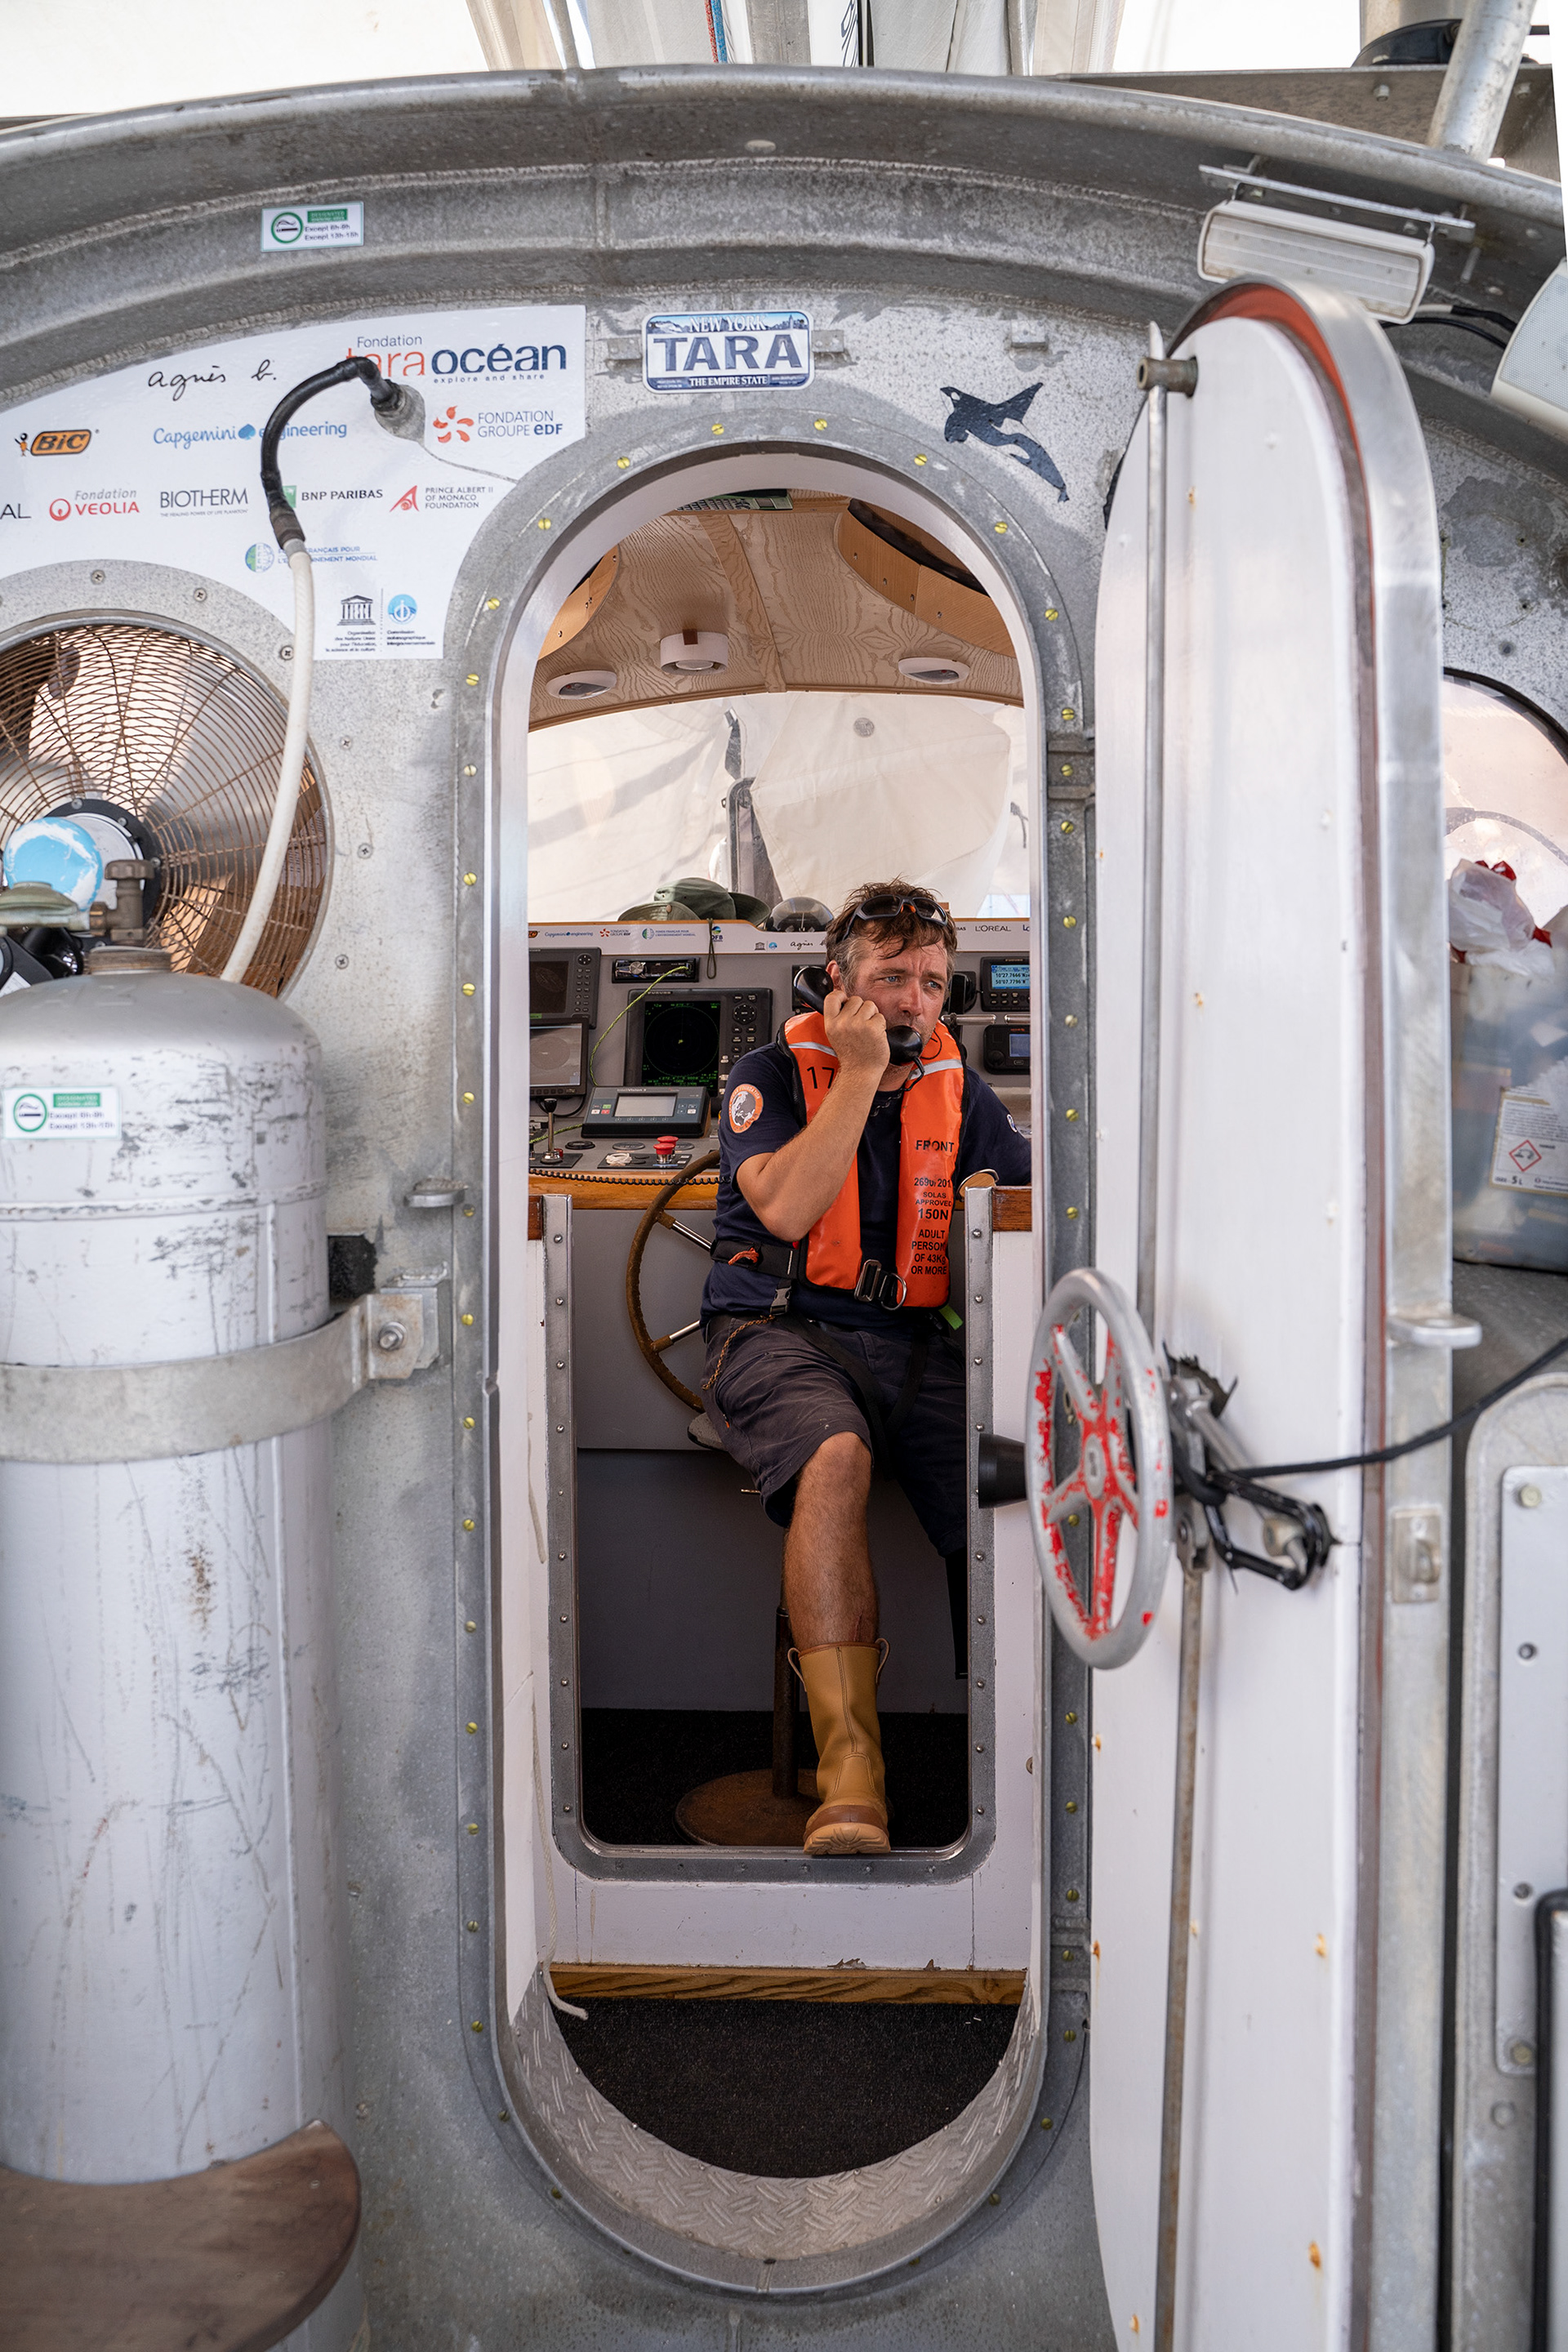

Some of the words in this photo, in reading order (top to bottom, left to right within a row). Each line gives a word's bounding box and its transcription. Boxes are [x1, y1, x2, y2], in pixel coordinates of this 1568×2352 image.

[689, 317, 723, 333] NEW
[725, 315, 766, 332] YORK
[357, 335, 423, 348] Fondation
[431, 343, 567, 374] océan
[653, 334, 802, 372] TARA
[688, 377, 707, 387] THE
[708, 376, 741, 386] EMPIRE
[742, 375, 768, 385] STATE
[478, 410, 554, 424] FONDATION
[153, 426, 237, 450] Capgemini
[259, 421, 347, 441] eineering
[478, 425, 530, 438] GROUPE
[74, 488, 137, 500] Fondation
[160, 488, 249, 508] BIOTHERM
[301, 491, 327, 501] BNP
[330, 489, 383, 500] PARIBAS
[75, 501, 140, 516] VEOLIA
[807, 1066, 835, 1089] 17
[915, 1140, 954, 1152] FRONT
[918, 1208, 949, 1220] 150N
[918, 1229, 945, 1239] ADULT
[914, 1253, 926, 1262] OF
[927, 1254, 947, 1265] 43Kg
[911, 1265, 923, 1274] OR
[925, 1266, 947, 1274] MORE
